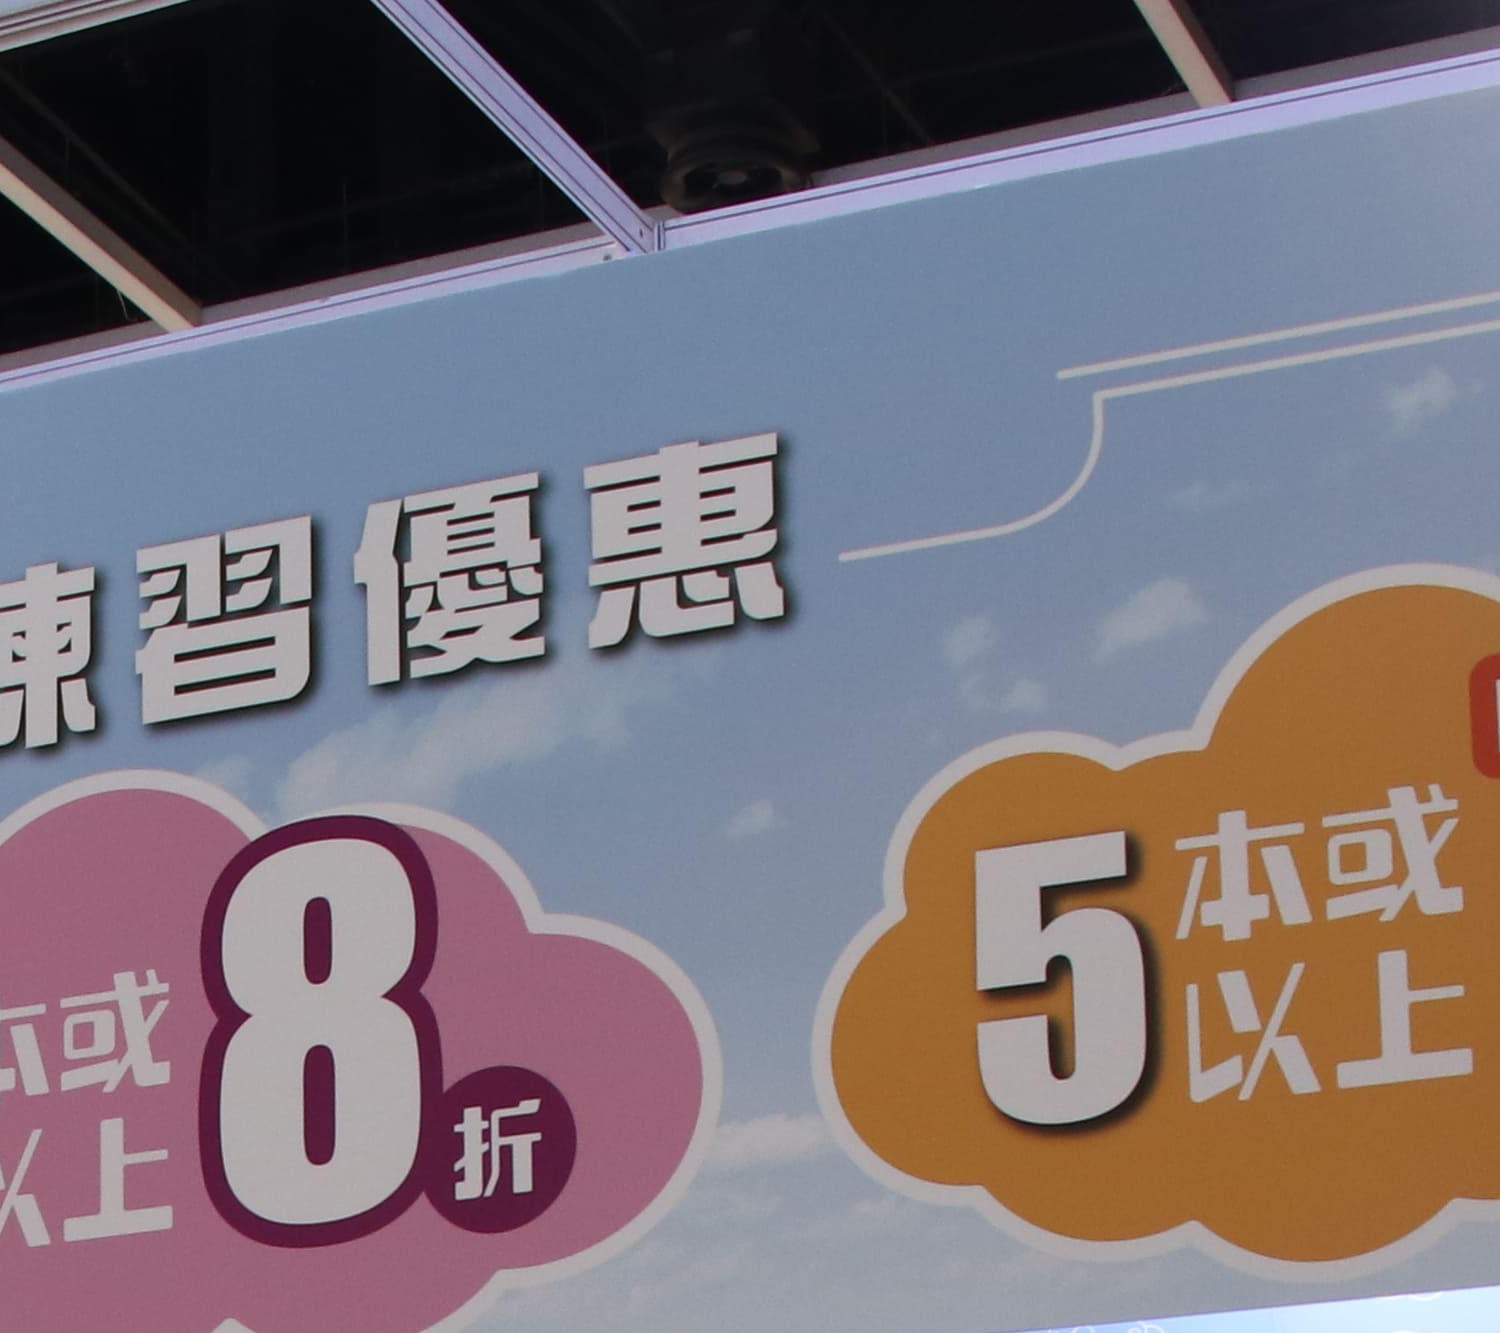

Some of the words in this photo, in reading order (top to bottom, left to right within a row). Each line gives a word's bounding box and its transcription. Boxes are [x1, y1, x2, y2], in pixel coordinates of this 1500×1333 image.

[217, 836, 424, 1227] 8
[451, 1097, 543, 1203] 折
[974, 829, 1149, 1127] 5
